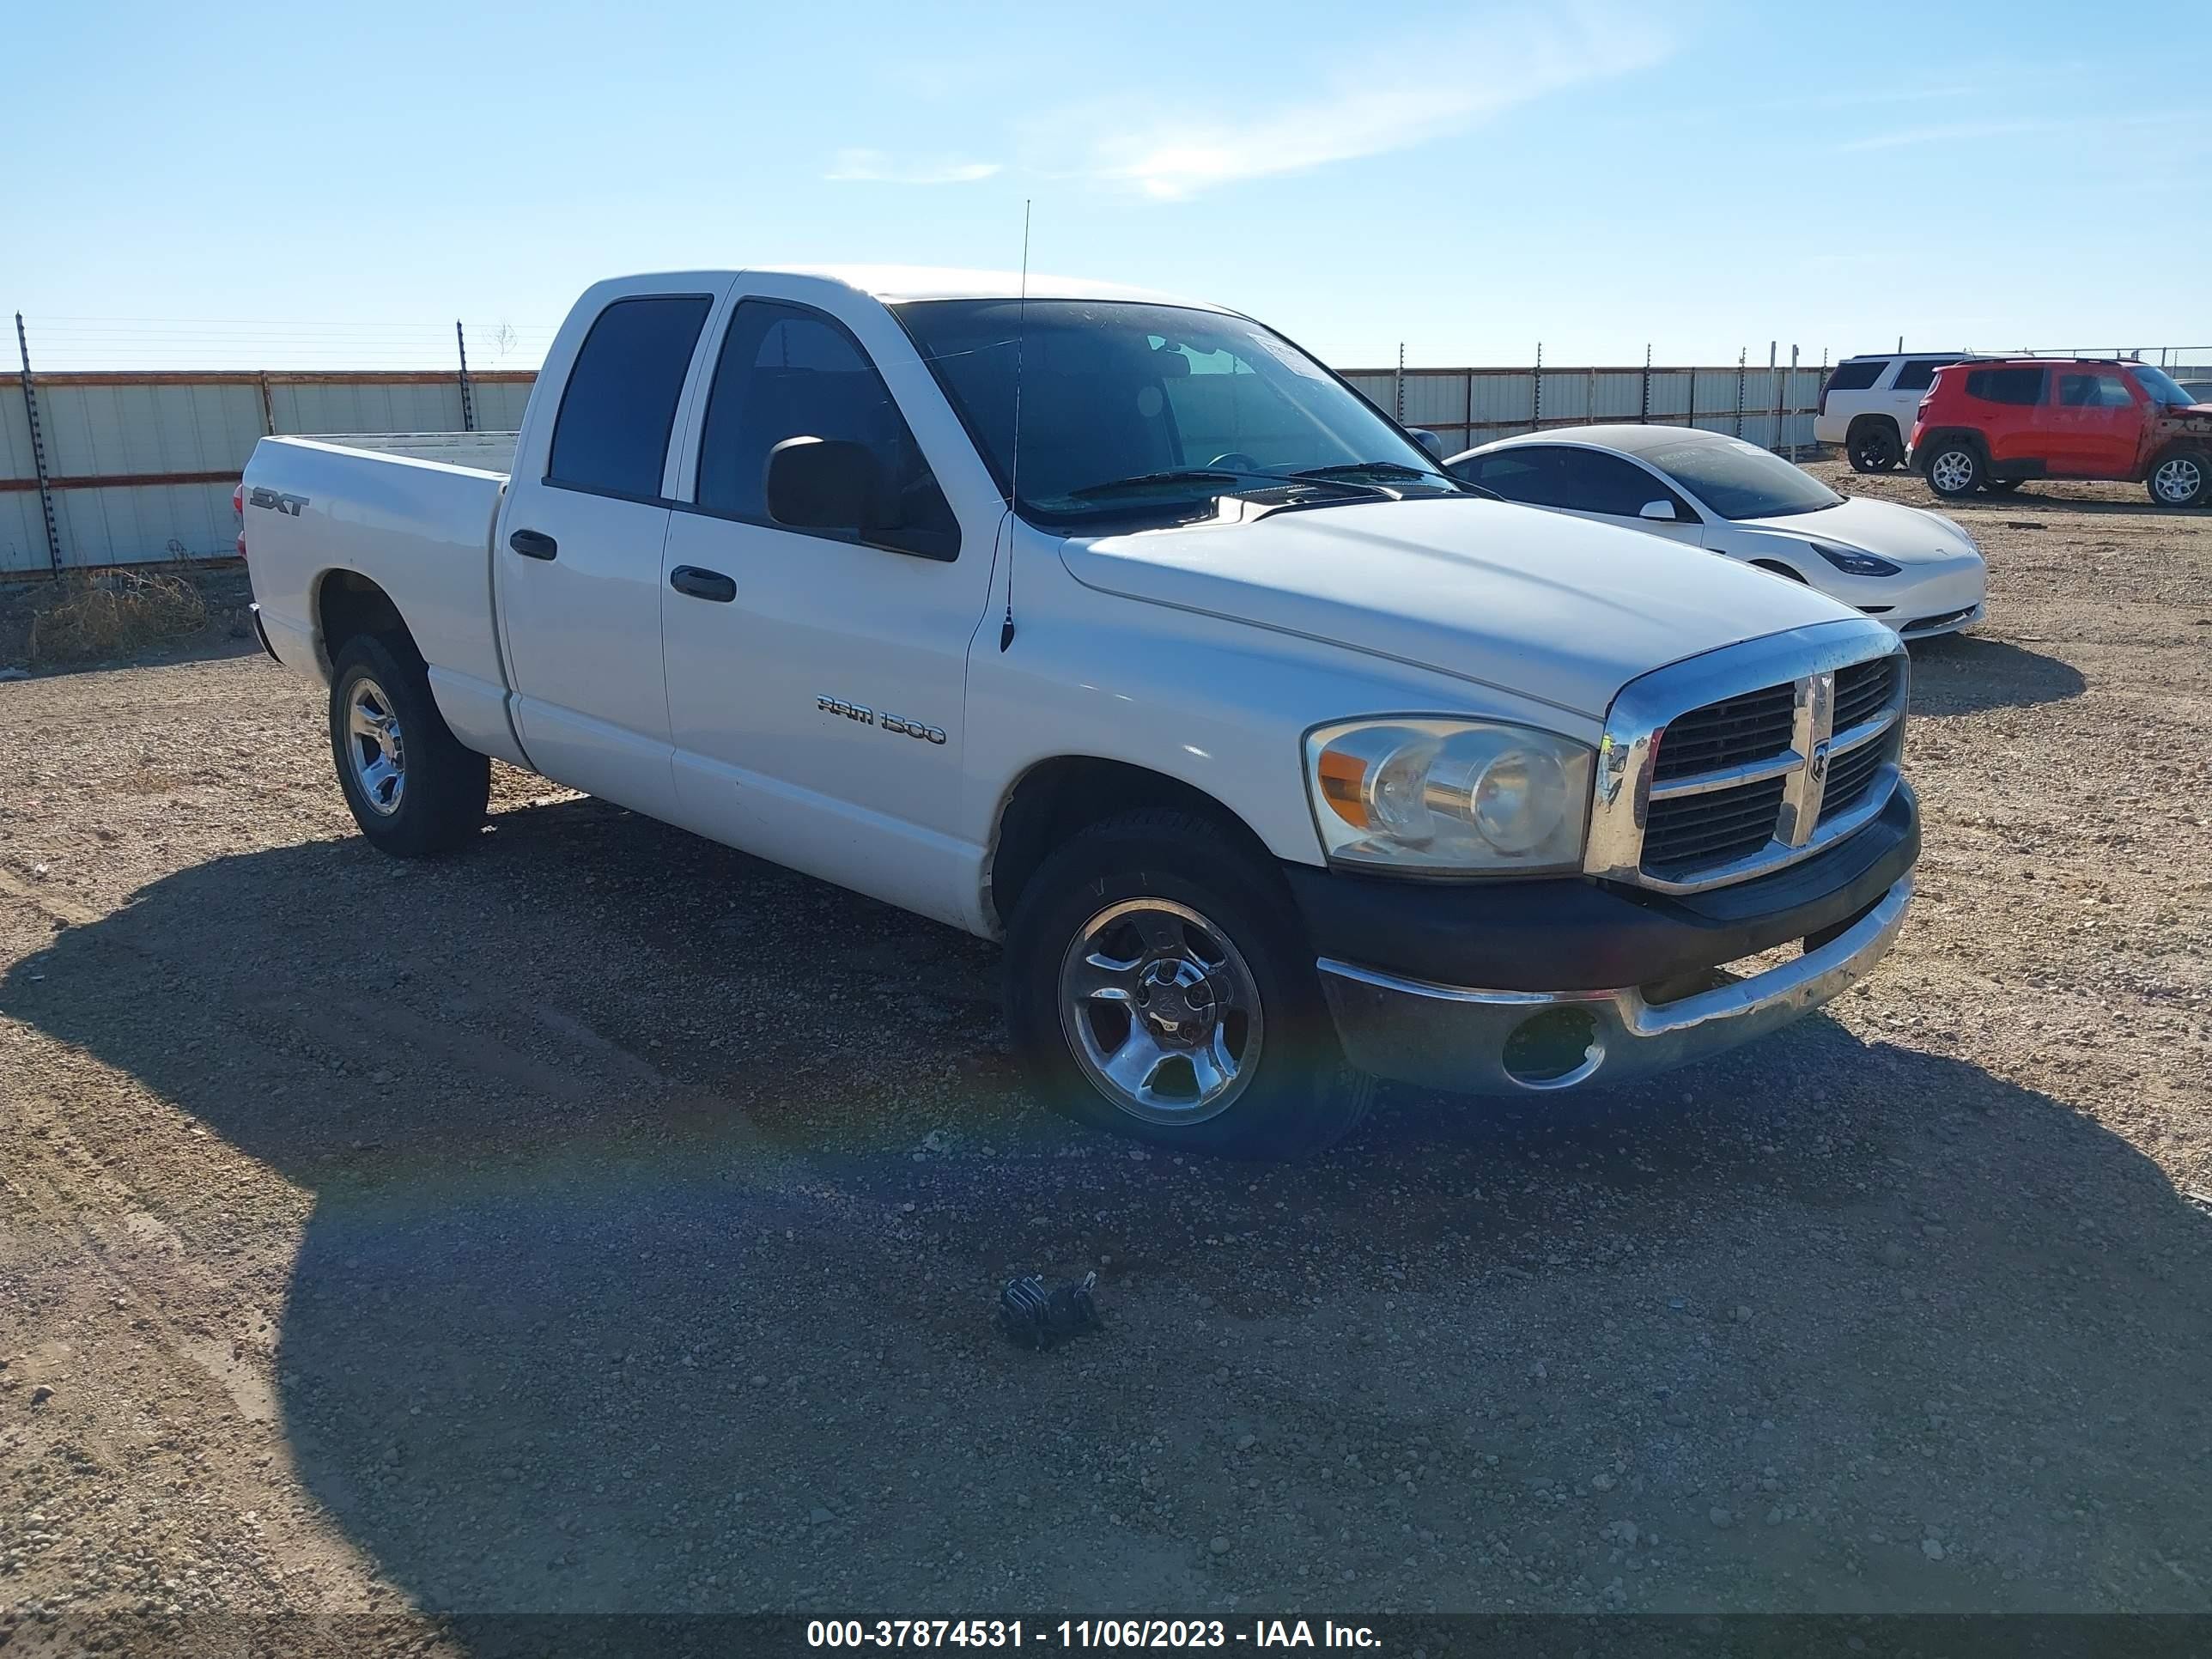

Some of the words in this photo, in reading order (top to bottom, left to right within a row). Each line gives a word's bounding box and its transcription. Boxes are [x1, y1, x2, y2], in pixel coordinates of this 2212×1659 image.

[250, 487, 310, 517] SXT
[817, 694, 873, 725] RAM
[879, 712, 946, 744] 1500
